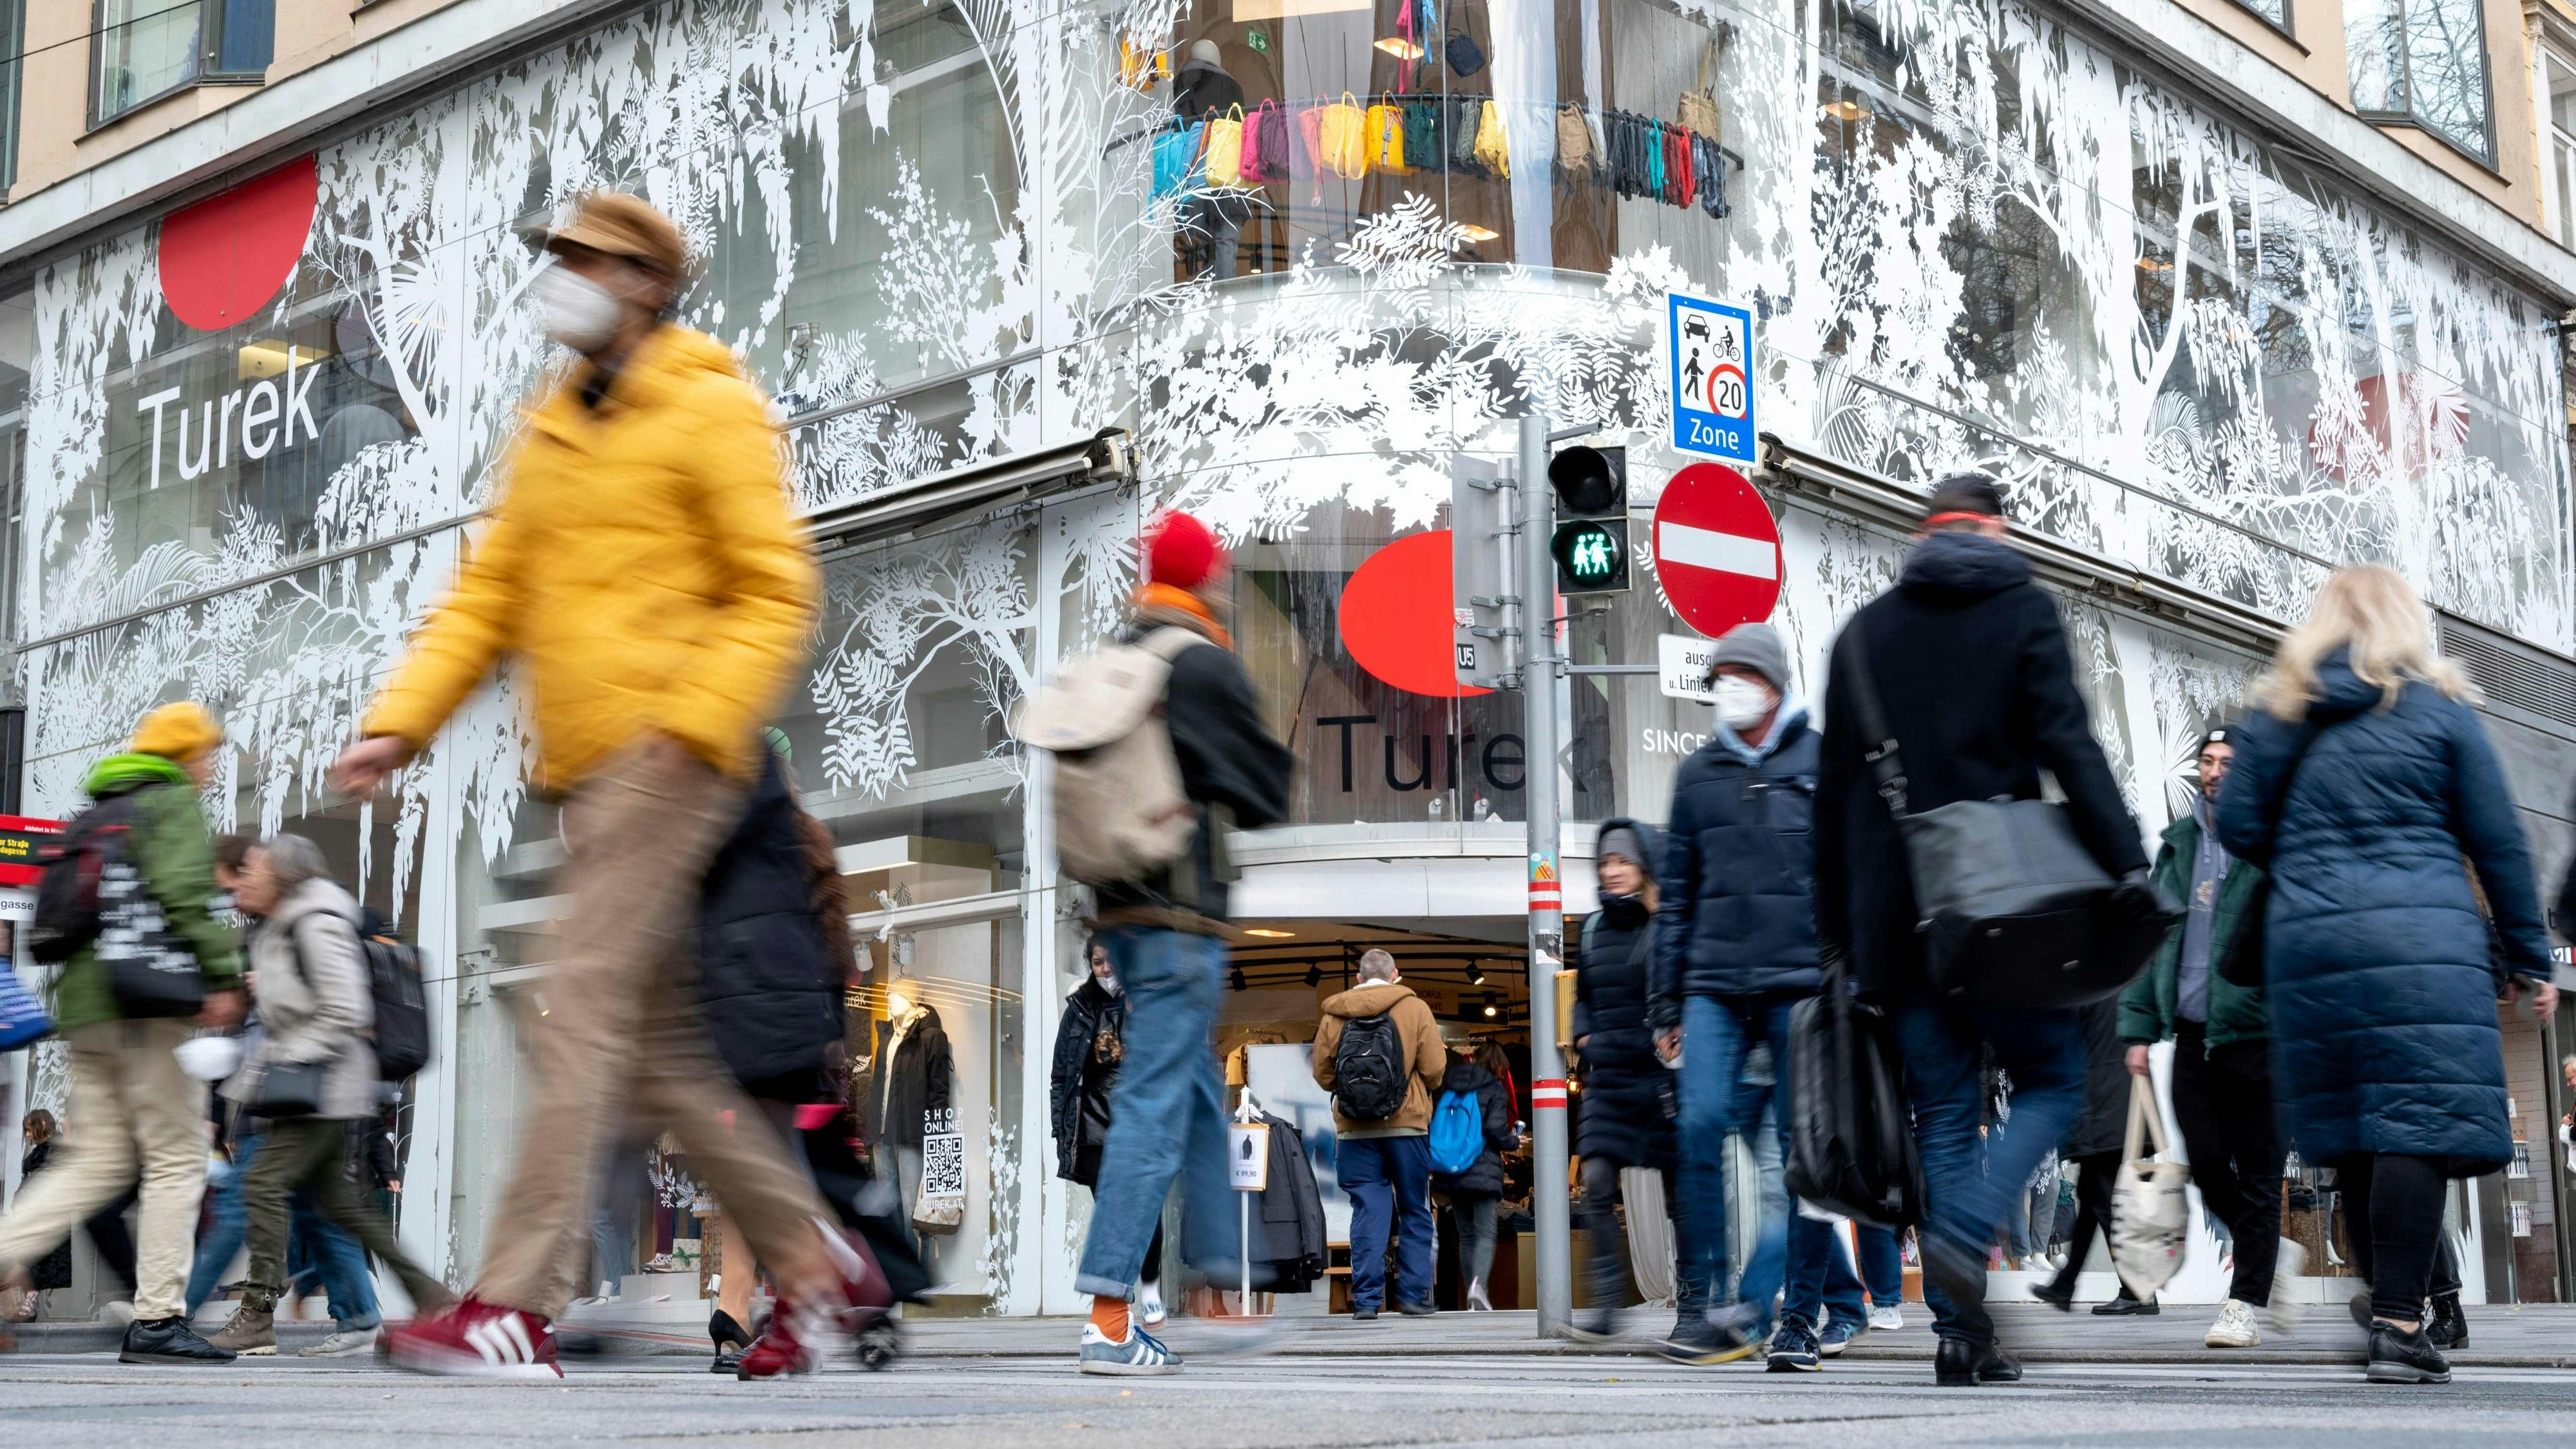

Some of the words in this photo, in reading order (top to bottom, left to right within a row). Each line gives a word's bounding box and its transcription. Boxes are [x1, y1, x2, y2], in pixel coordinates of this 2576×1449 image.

[1718, 379, 1741, 411] 20
[137, 345, 321, 490] Turek
[1690, 417, 1739, 451] Zone
[1457, 646, 1475, 667] U5
[1669, 679, 1676, 689] u.
[1642, 728, 1707, 756] SINCE
[7, 838, 29, 849] Straße
[924, 1107, 963, 1121] SHOP
[924, 1119, 963, 1133] ONLINE!
[924, 1198, 962, 1210] TUREK.AT
